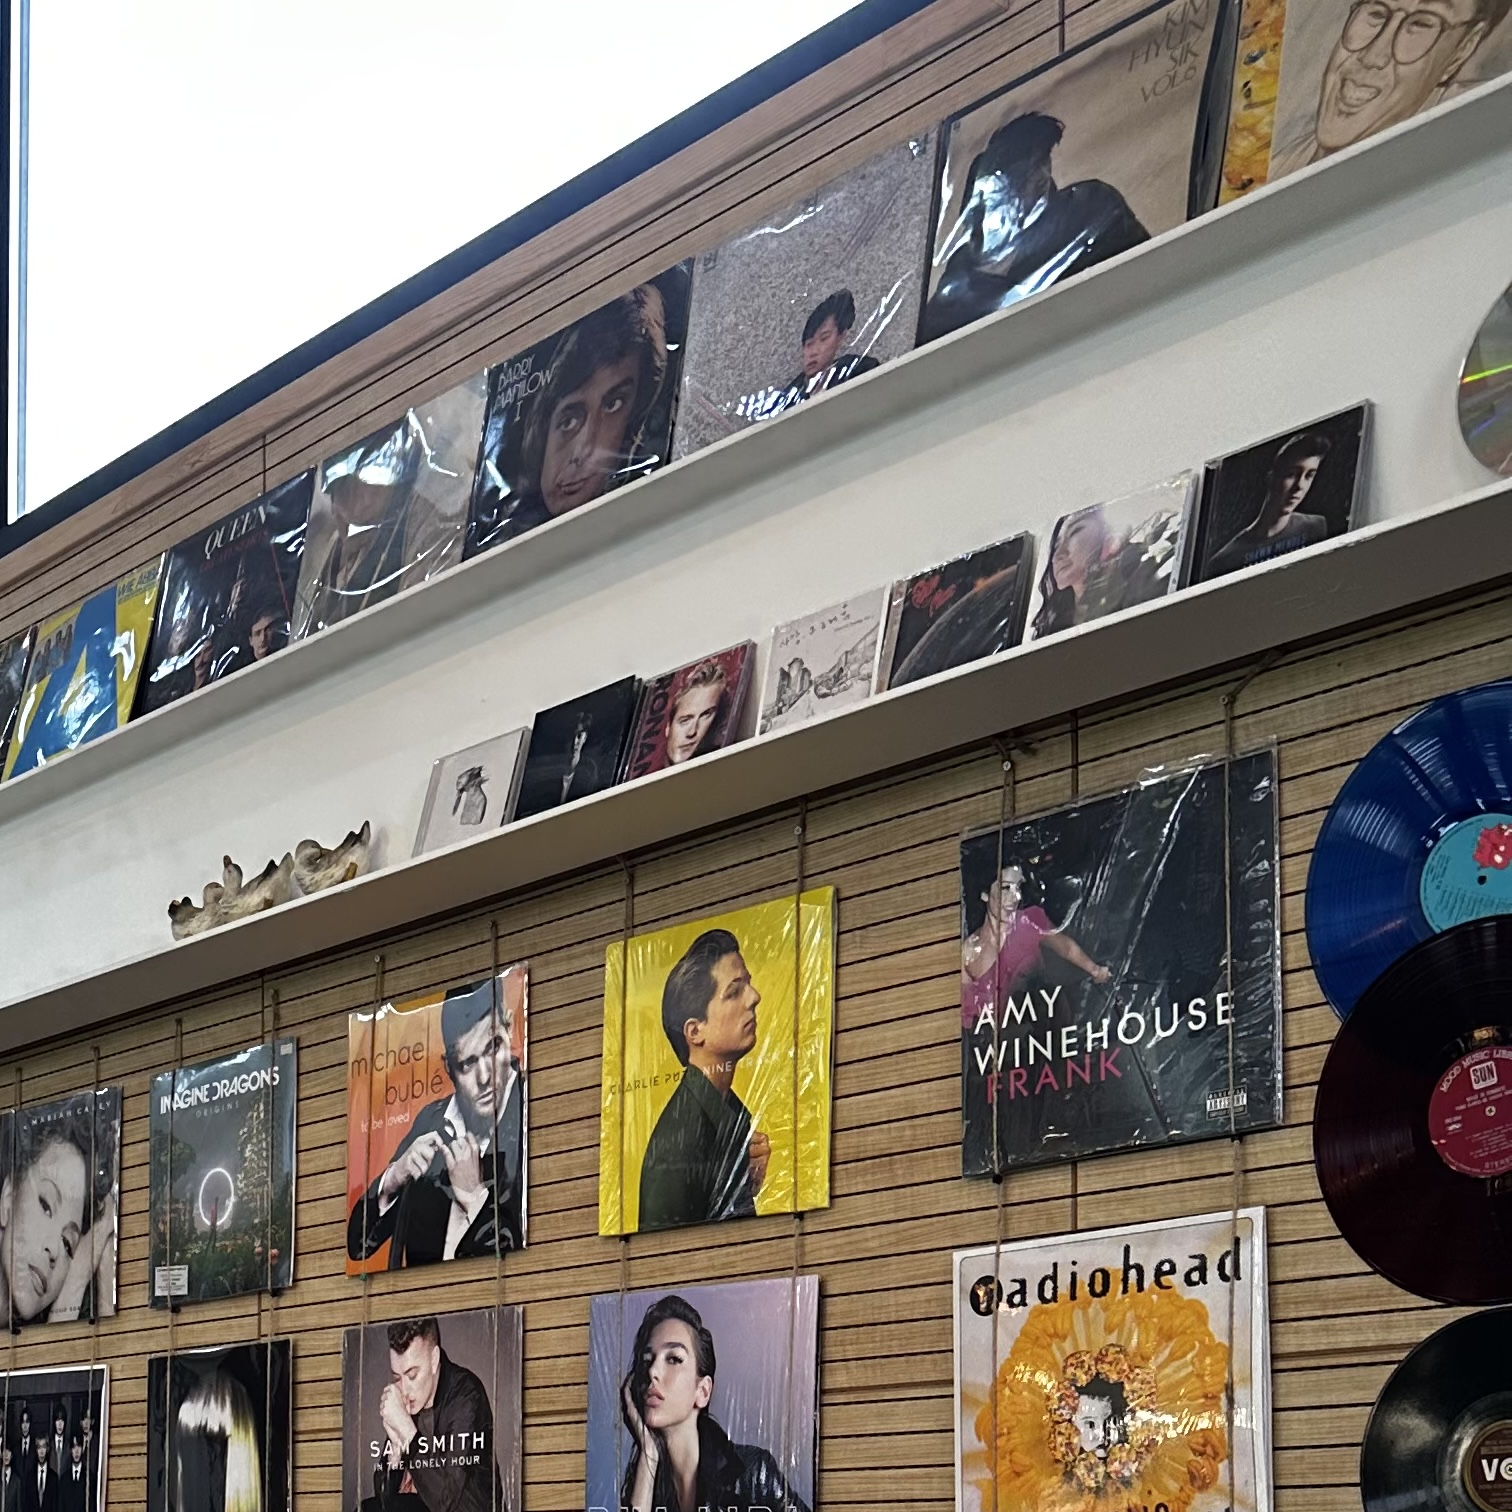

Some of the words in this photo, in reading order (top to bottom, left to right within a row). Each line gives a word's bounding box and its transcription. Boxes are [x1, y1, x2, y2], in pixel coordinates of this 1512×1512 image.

[204, 504, 267, 560] QUEEN
[974, 985, 1063, 1035] AMY
[974, 990, 1236, 1077] WINEHOUSE
[702, 1060, 734, 1077] NINE
[987, 1047, 1123, 1105] FRANK
[1471, 1063, 1495, 1085] SUN
[212, 1066, 280, 1100] DRAGONS
[31, 1110, 72, 1126] MARIAH
[195, 1100, 240, 1118] ORIGINS
[370, 1438, 410, 1459] SAM
[417, 1431, 486, 1455] SMITH
[373, 1462, 383, 1473] IN
[387, 1460, 405, 1471] THE
[409, 1457, 447, 1470] LONELY
[451, 1455, 481, 1467] HOUR
